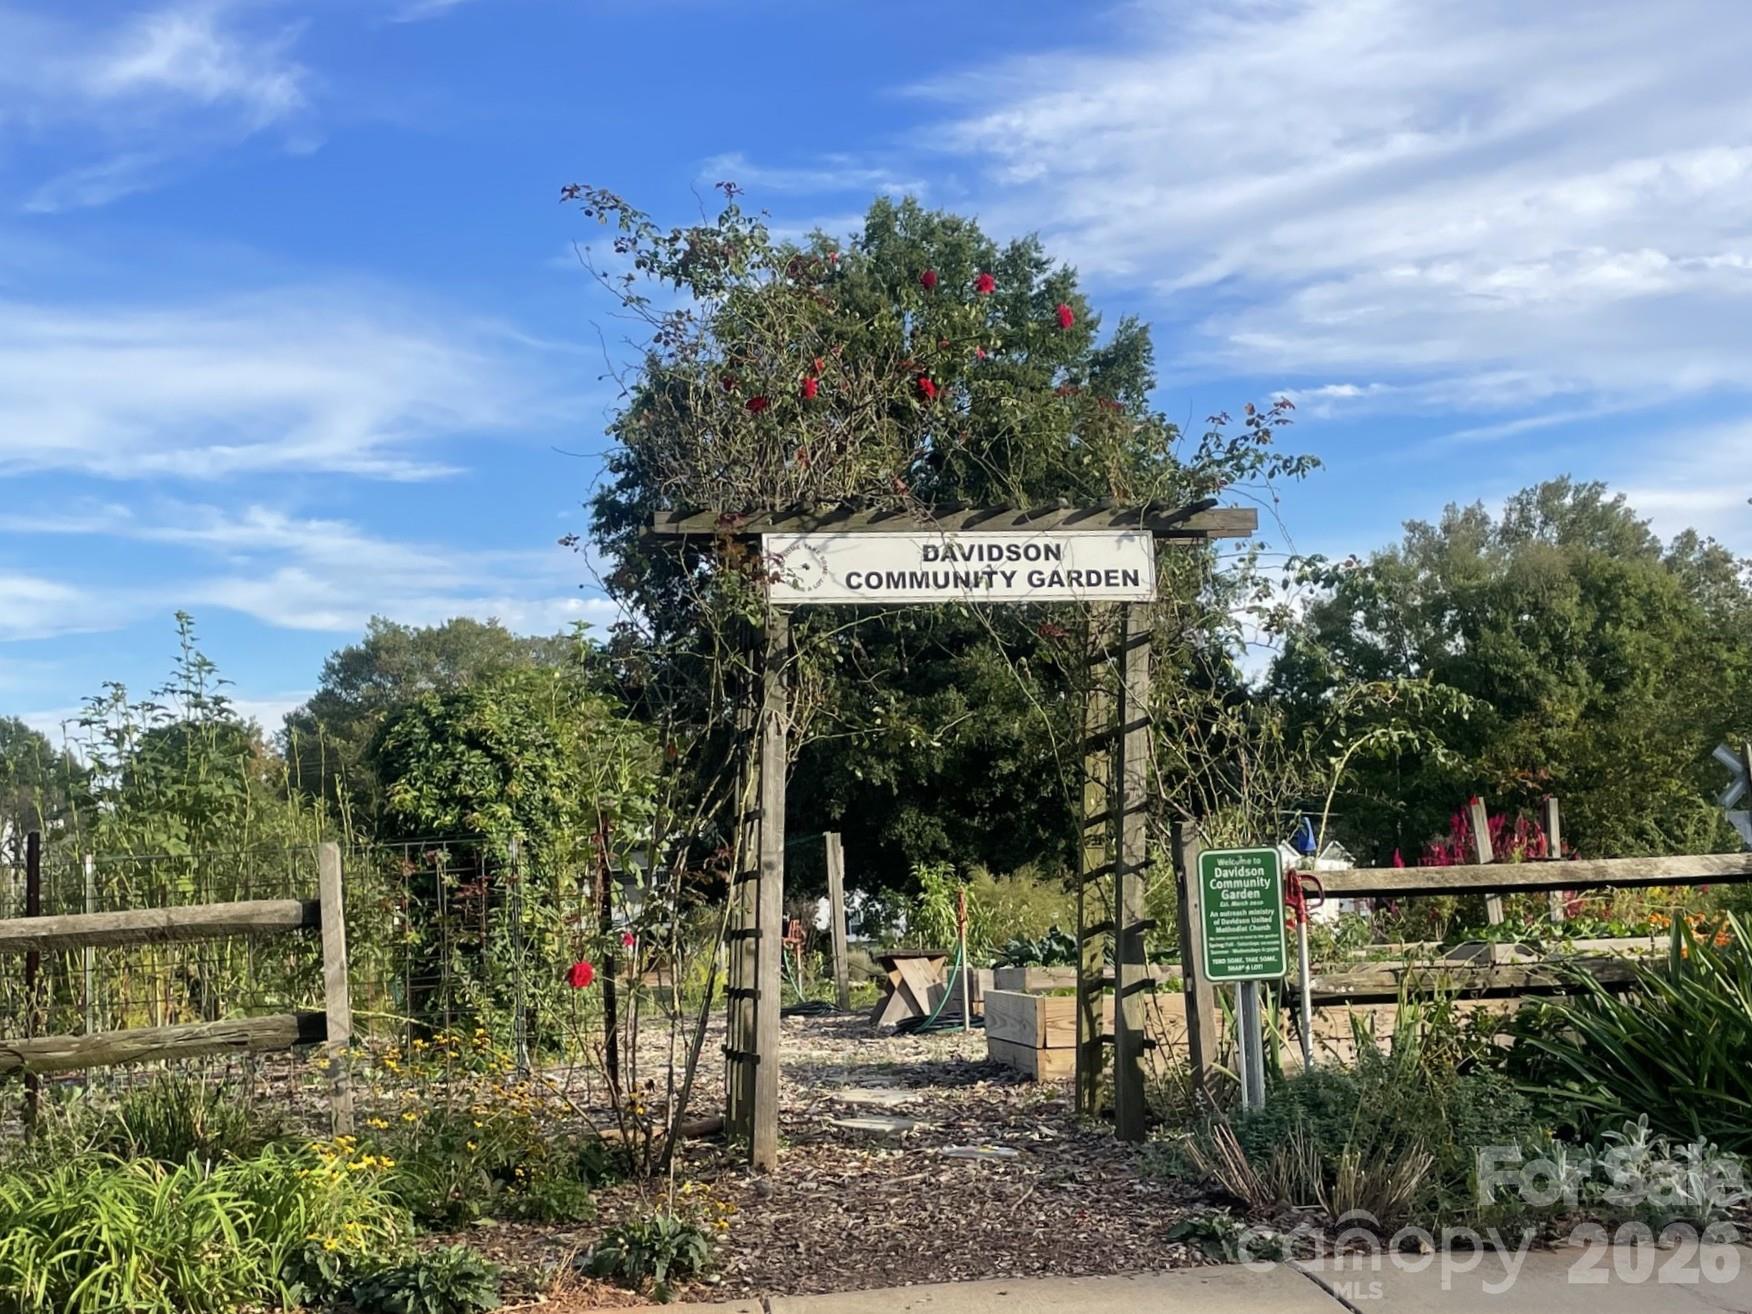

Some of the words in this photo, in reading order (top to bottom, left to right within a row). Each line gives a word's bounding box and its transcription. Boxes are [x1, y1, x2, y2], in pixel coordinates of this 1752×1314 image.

[922, 543, 1062, 562] DAVIDSON
[845, 570, 1017, 590] COMMUNITY
[1027, 569, 1140, 588] GARDEN
[1217, 858, 1252, 866] Welcome
[1214, 866, 1265, 878] Davidson
[1209, 876, 1271, 890] Community
[1221, 888, 1261, 900] Garden
[1248, 908, 1275, 916] ministry
[1213, 918, 1221, 926] of
[1251, 916, 1273, 924] United
[1215, 925, 1248, 933] Methodist
[1249, 924, 1272, 932] Church
